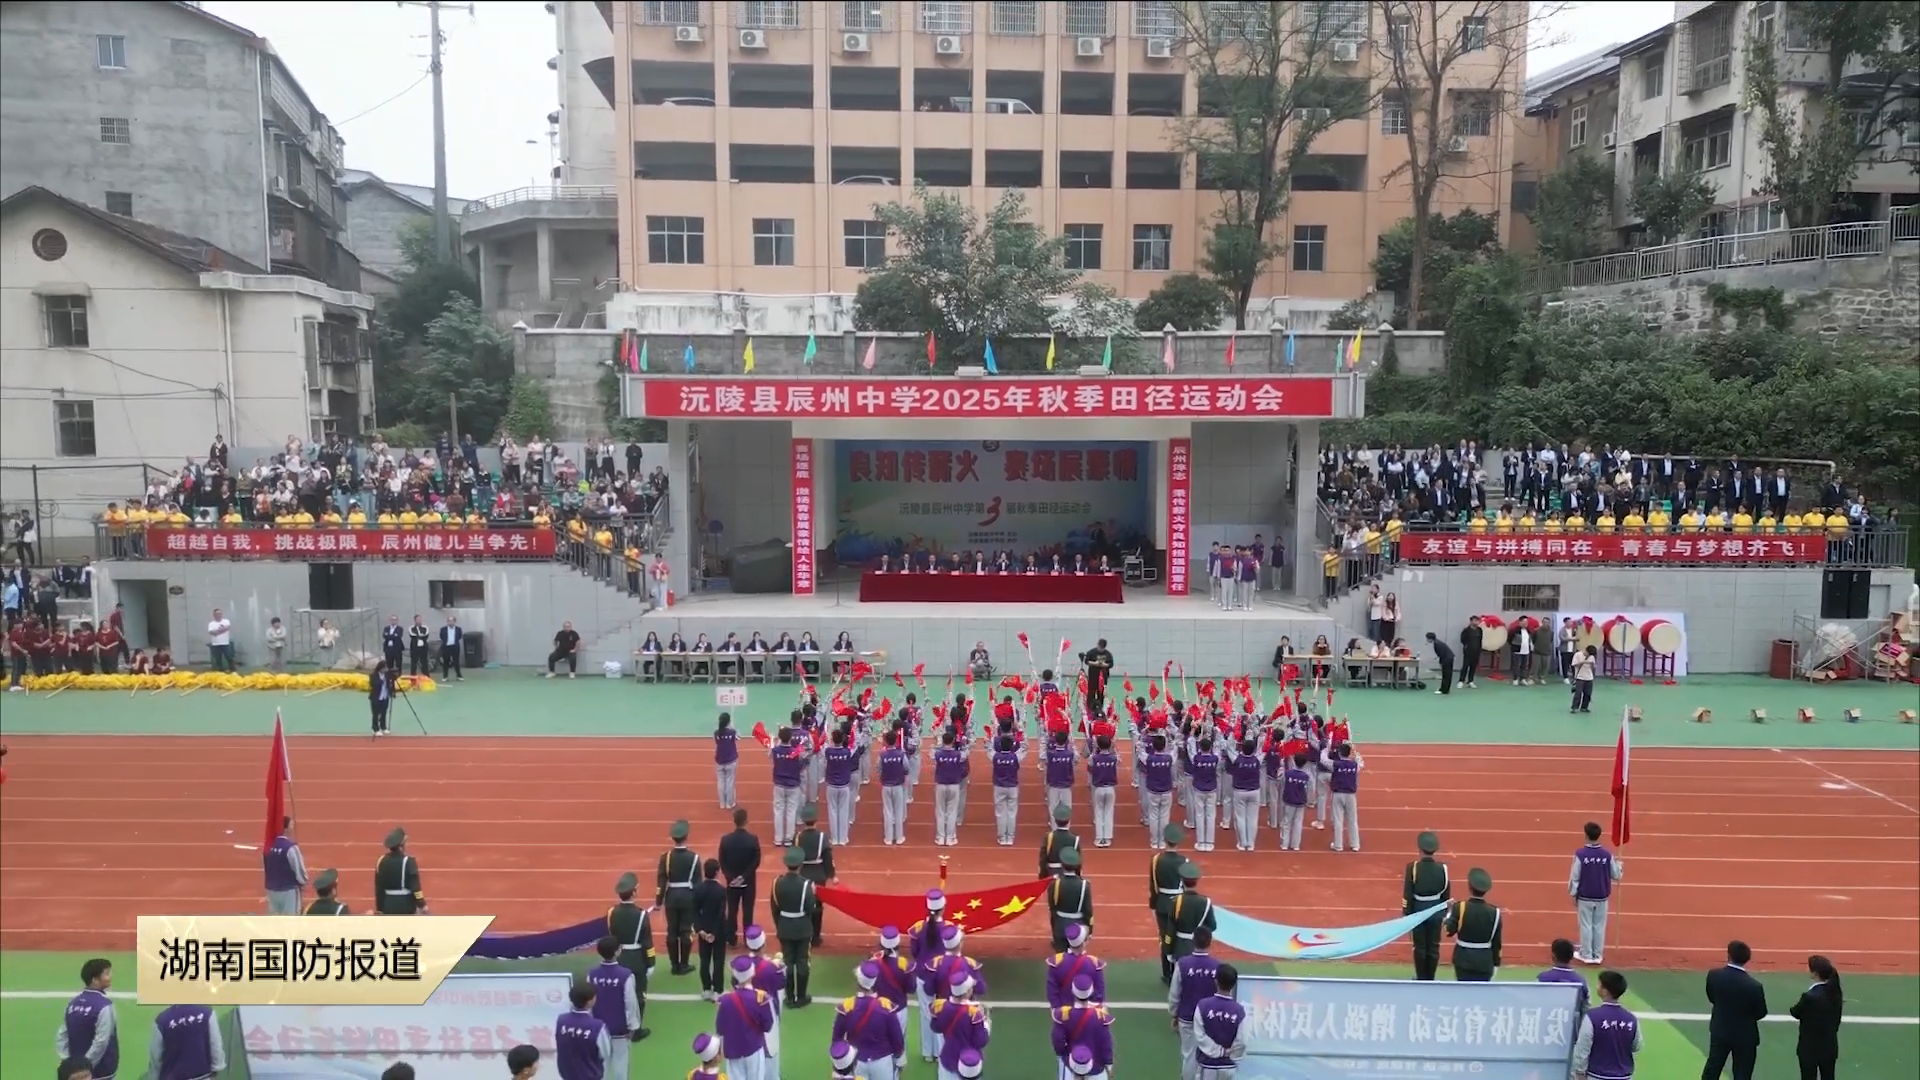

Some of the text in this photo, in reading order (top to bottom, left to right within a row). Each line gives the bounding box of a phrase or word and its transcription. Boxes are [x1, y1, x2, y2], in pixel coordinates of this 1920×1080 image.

[679, 384, 1284, 414] 沅陵县辰州中学2025年秋季田径运动会
[850, 449, 980, 483] 良知传薪火
[167, 533, 538, 552] 超越自我，挑战极限，辰州健儿当争先！
[1421, 538, 1807, 558] 友谊与拼搏同在，青春与梦想齐飞！
